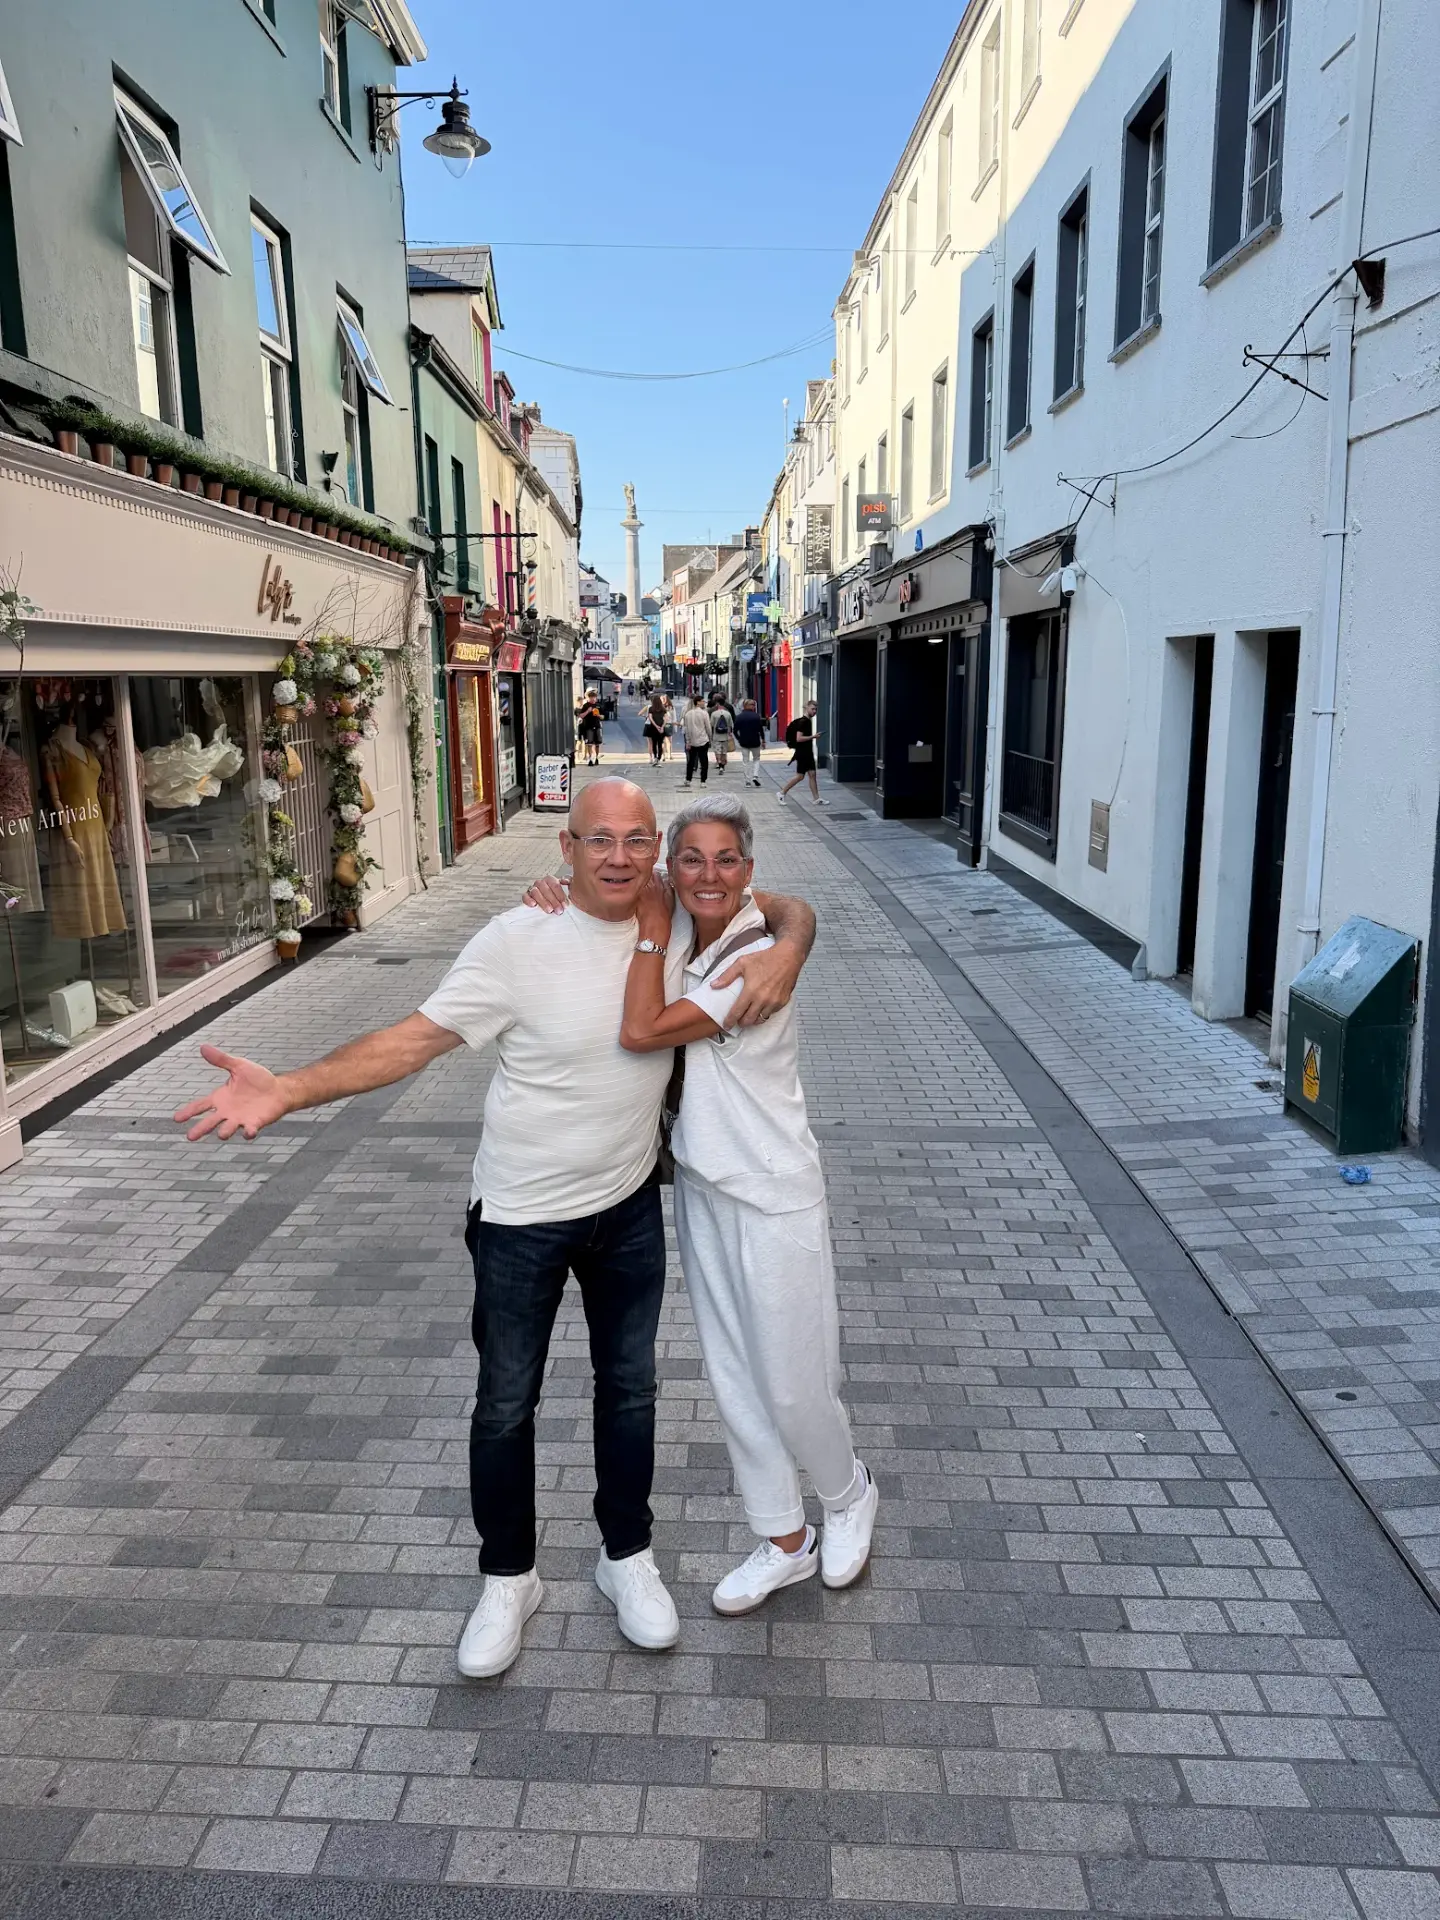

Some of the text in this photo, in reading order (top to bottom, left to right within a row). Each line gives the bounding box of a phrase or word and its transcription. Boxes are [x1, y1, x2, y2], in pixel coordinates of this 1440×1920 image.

[862, 501, 887, 516] ptsb
[822, 524, 830, 551] PAUL
[586, 641, 610, 650] DNG
[538, 763, 559, 773] Barber
[540, 774, 556, 784] Shop
[38, 798, 99, 830] Arrivals
